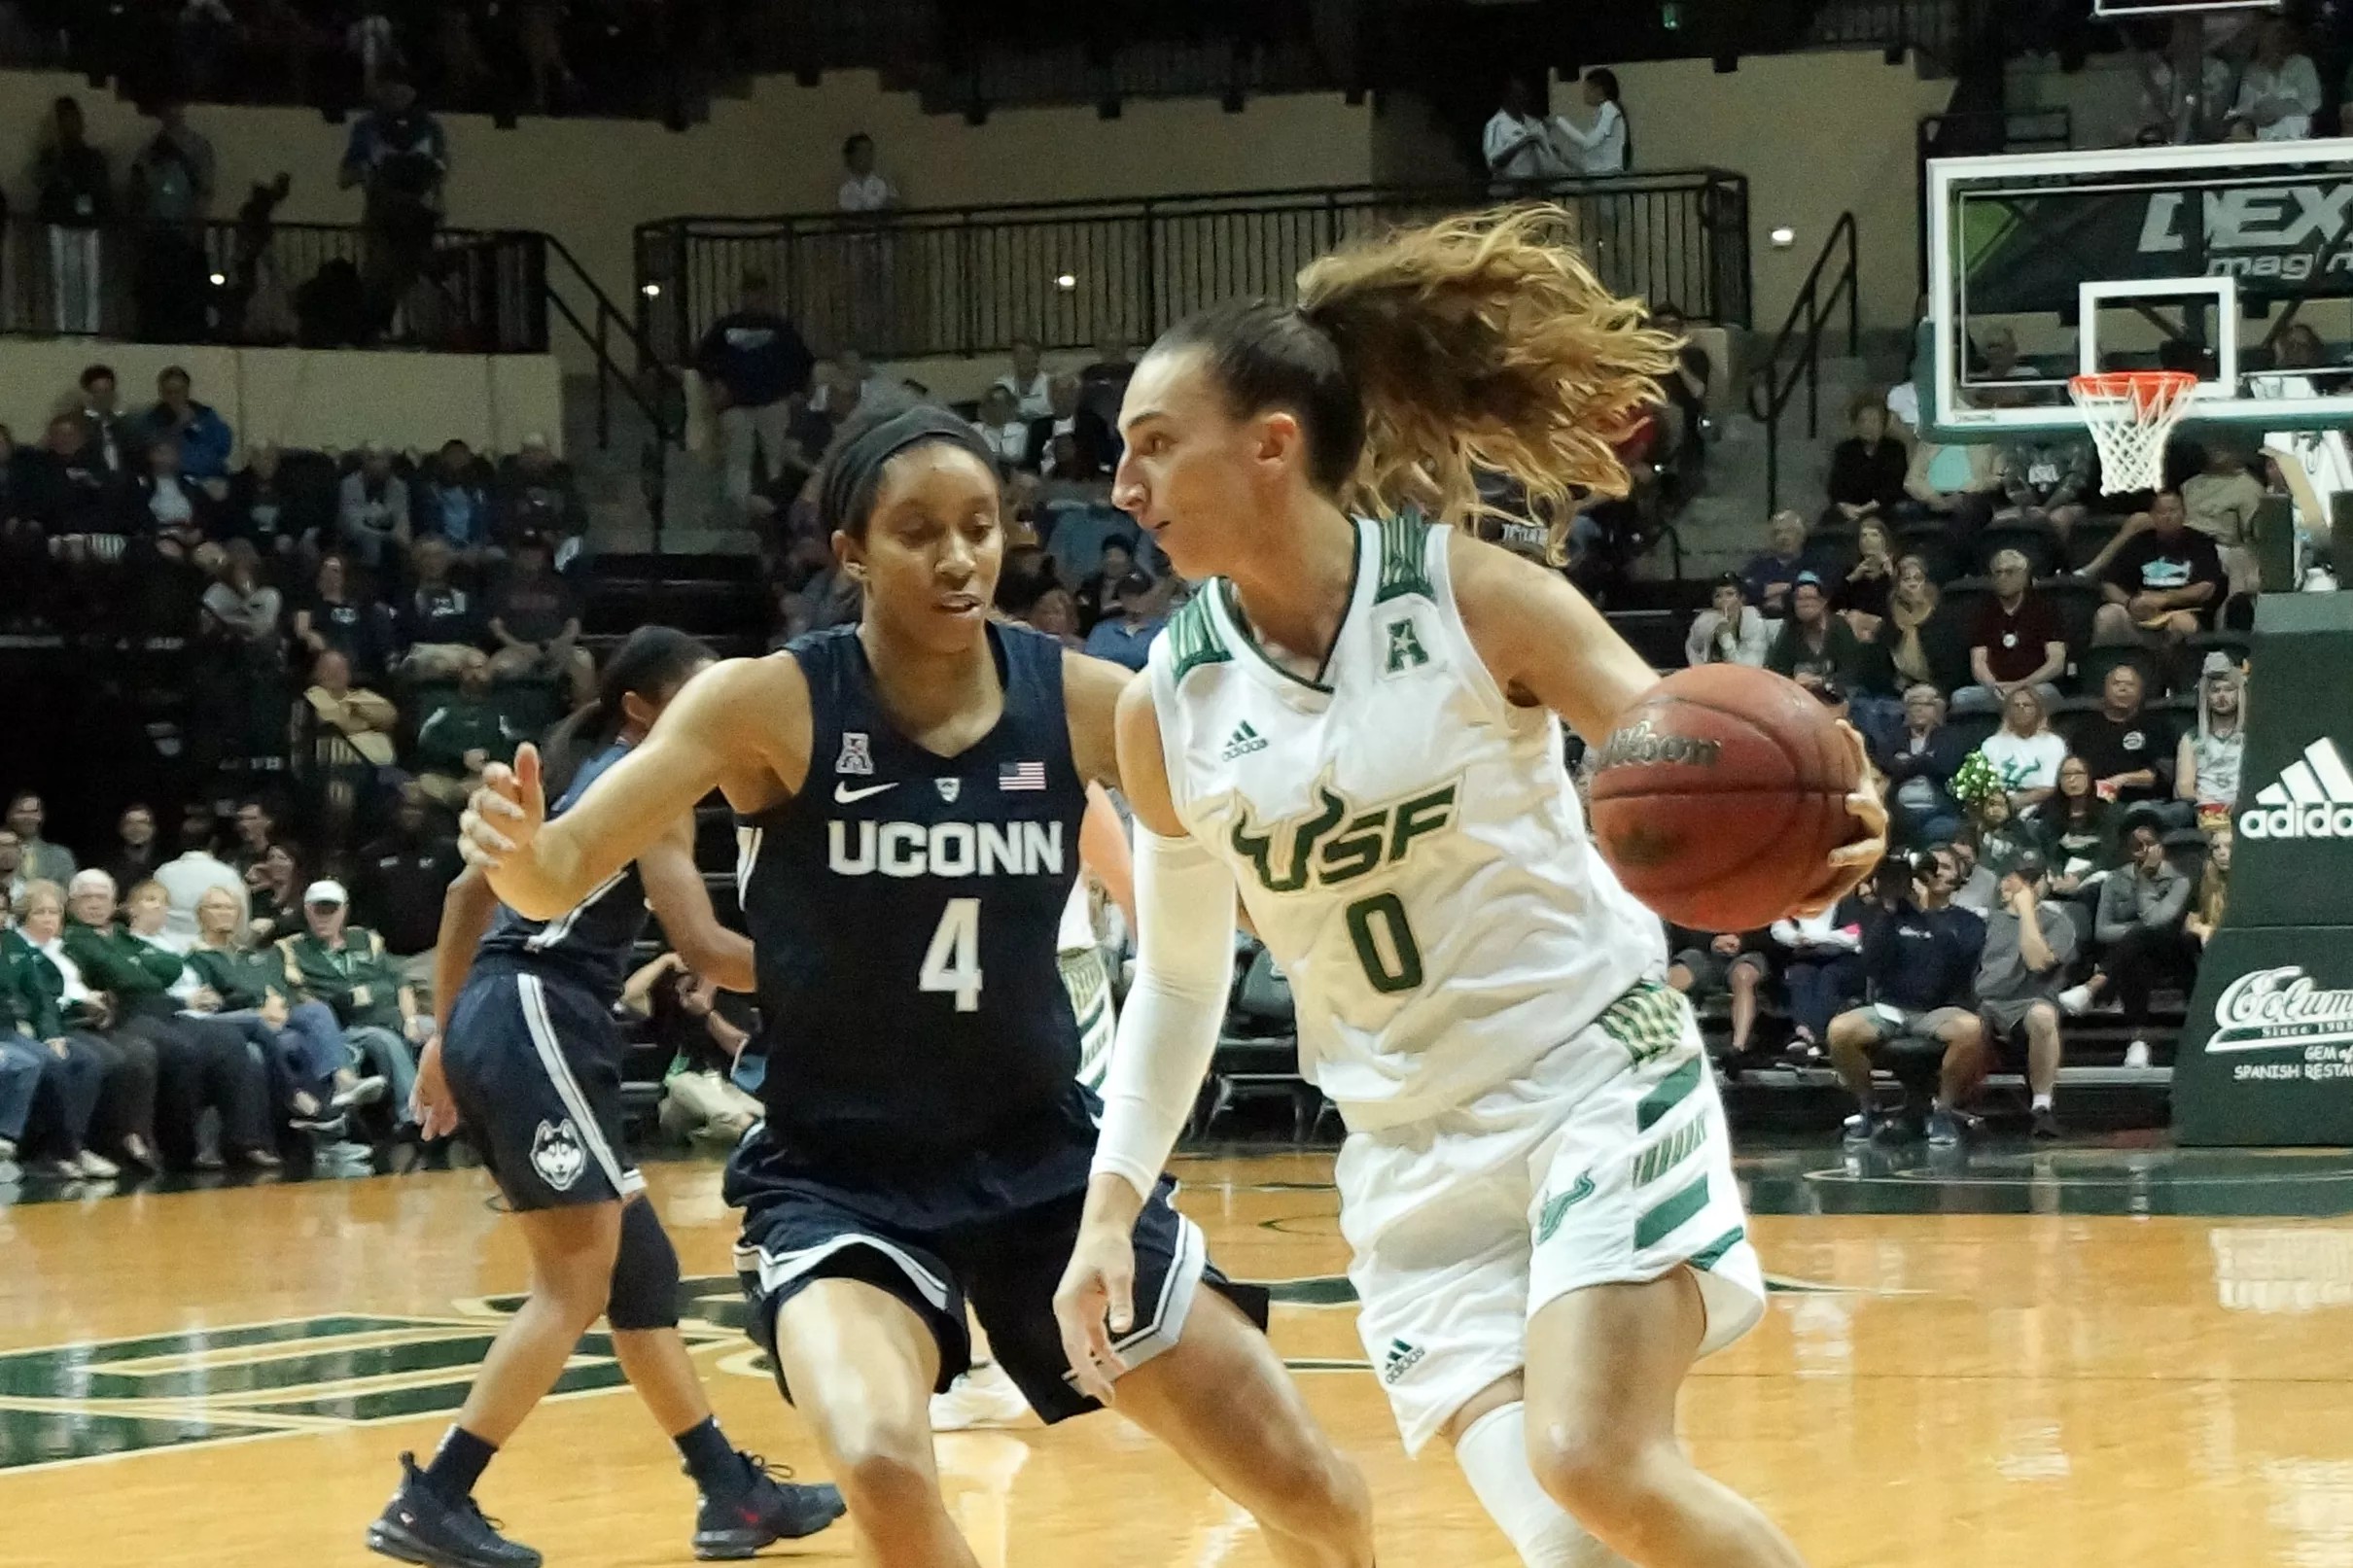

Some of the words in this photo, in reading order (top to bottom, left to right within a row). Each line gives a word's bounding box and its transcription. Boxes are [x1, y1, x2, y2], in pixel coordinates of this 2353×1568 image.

[827, 819, 1064, 877] UCONN
[1230, 784, 1458, 892] USF
[919, 897, 983, 1012] 4
[1345, 891, 1423, 993] 0
[2233, 1063, 2300, 1080] SPANISH
[2304, 1045, 2337, 1062] GEM
